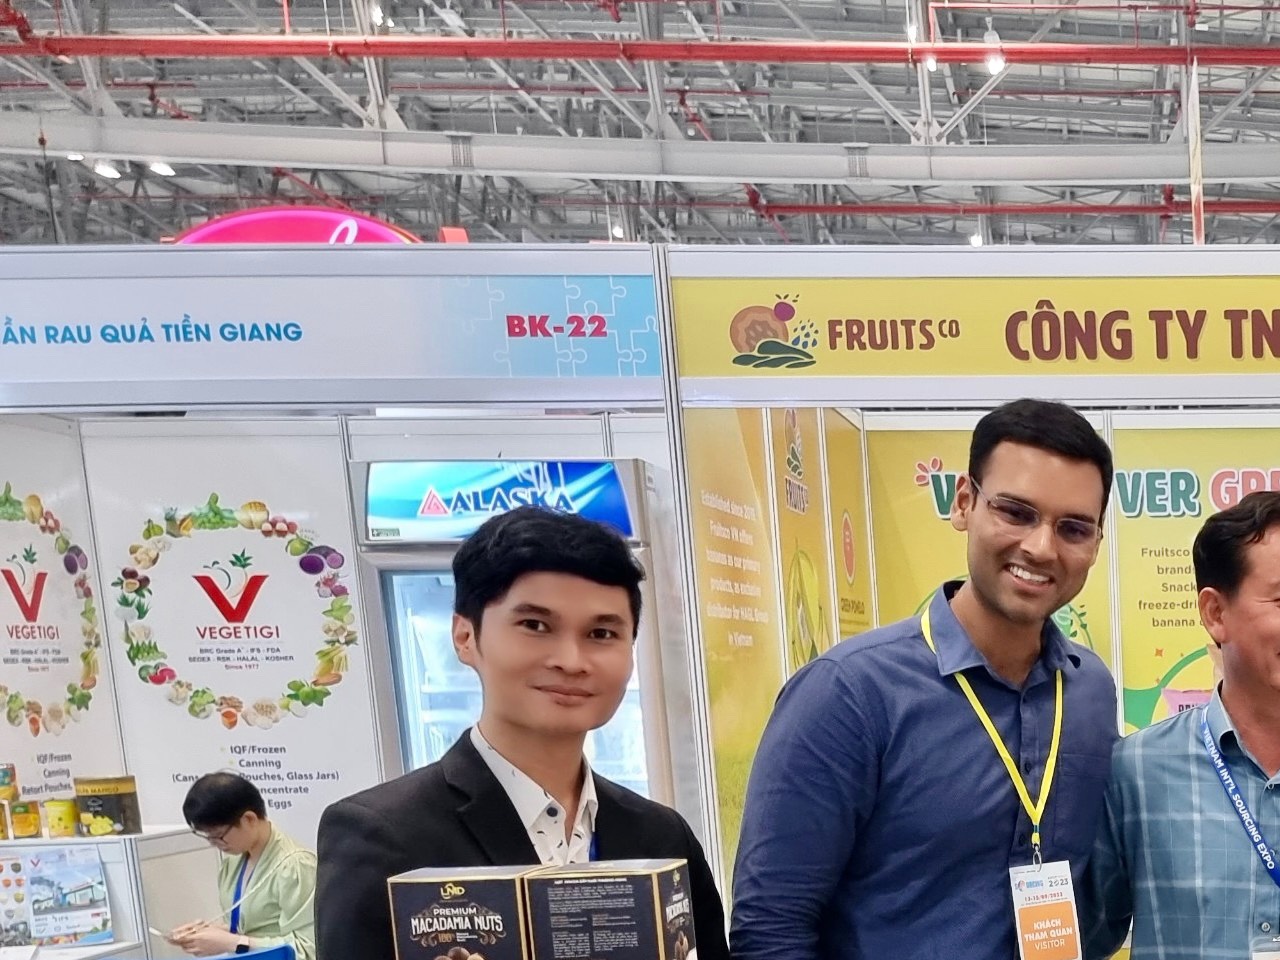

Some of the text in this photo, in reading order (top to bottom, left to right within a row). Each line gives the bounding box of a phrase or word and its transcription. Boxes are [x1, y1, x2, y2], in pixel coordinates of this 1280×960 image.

[45, 324, 92, 344] RAU
[100, 316, 154, 344] QUẢ
[161, 314, 211, 343] TIỀN
[219, 322, 302, 343] GIANG
[506, 314, 608, 337] BK-22
[1005, 299, 1133, 361] CÔNG
[1148, 309, 1207, 360] TY
[828, 318, 935, 351] FRUITS
[1141, 547, 1190, 558] Fruitsco
[1152, 617, 1195, 628] banana
[7, 625, 60, 640] VEGETIGI
[196, 626, 280, 640] VEGETIGI
[230, 744, 286, 756] IQF/Frozen
[239, 758, 281, 769] Canning
[287, 770, 312, 781] Glass
[268, 799, 292, 810] Eggs
[1203, 730, 1225, 770] VIETNAM
[1232, 793, 1263, 847] SOURCING
[1256, 842, 1275, 870] EXPO
[434, 907, 476, 916] PREMIUM
[411, 914, 503, 935] MACADAMIA NUTS
[1034, 918, 1061, 930] KHÁCH
[1024, 927, 1073, 942] THAM QUAN
[1035, 939, 1065, 950] VISITOR
